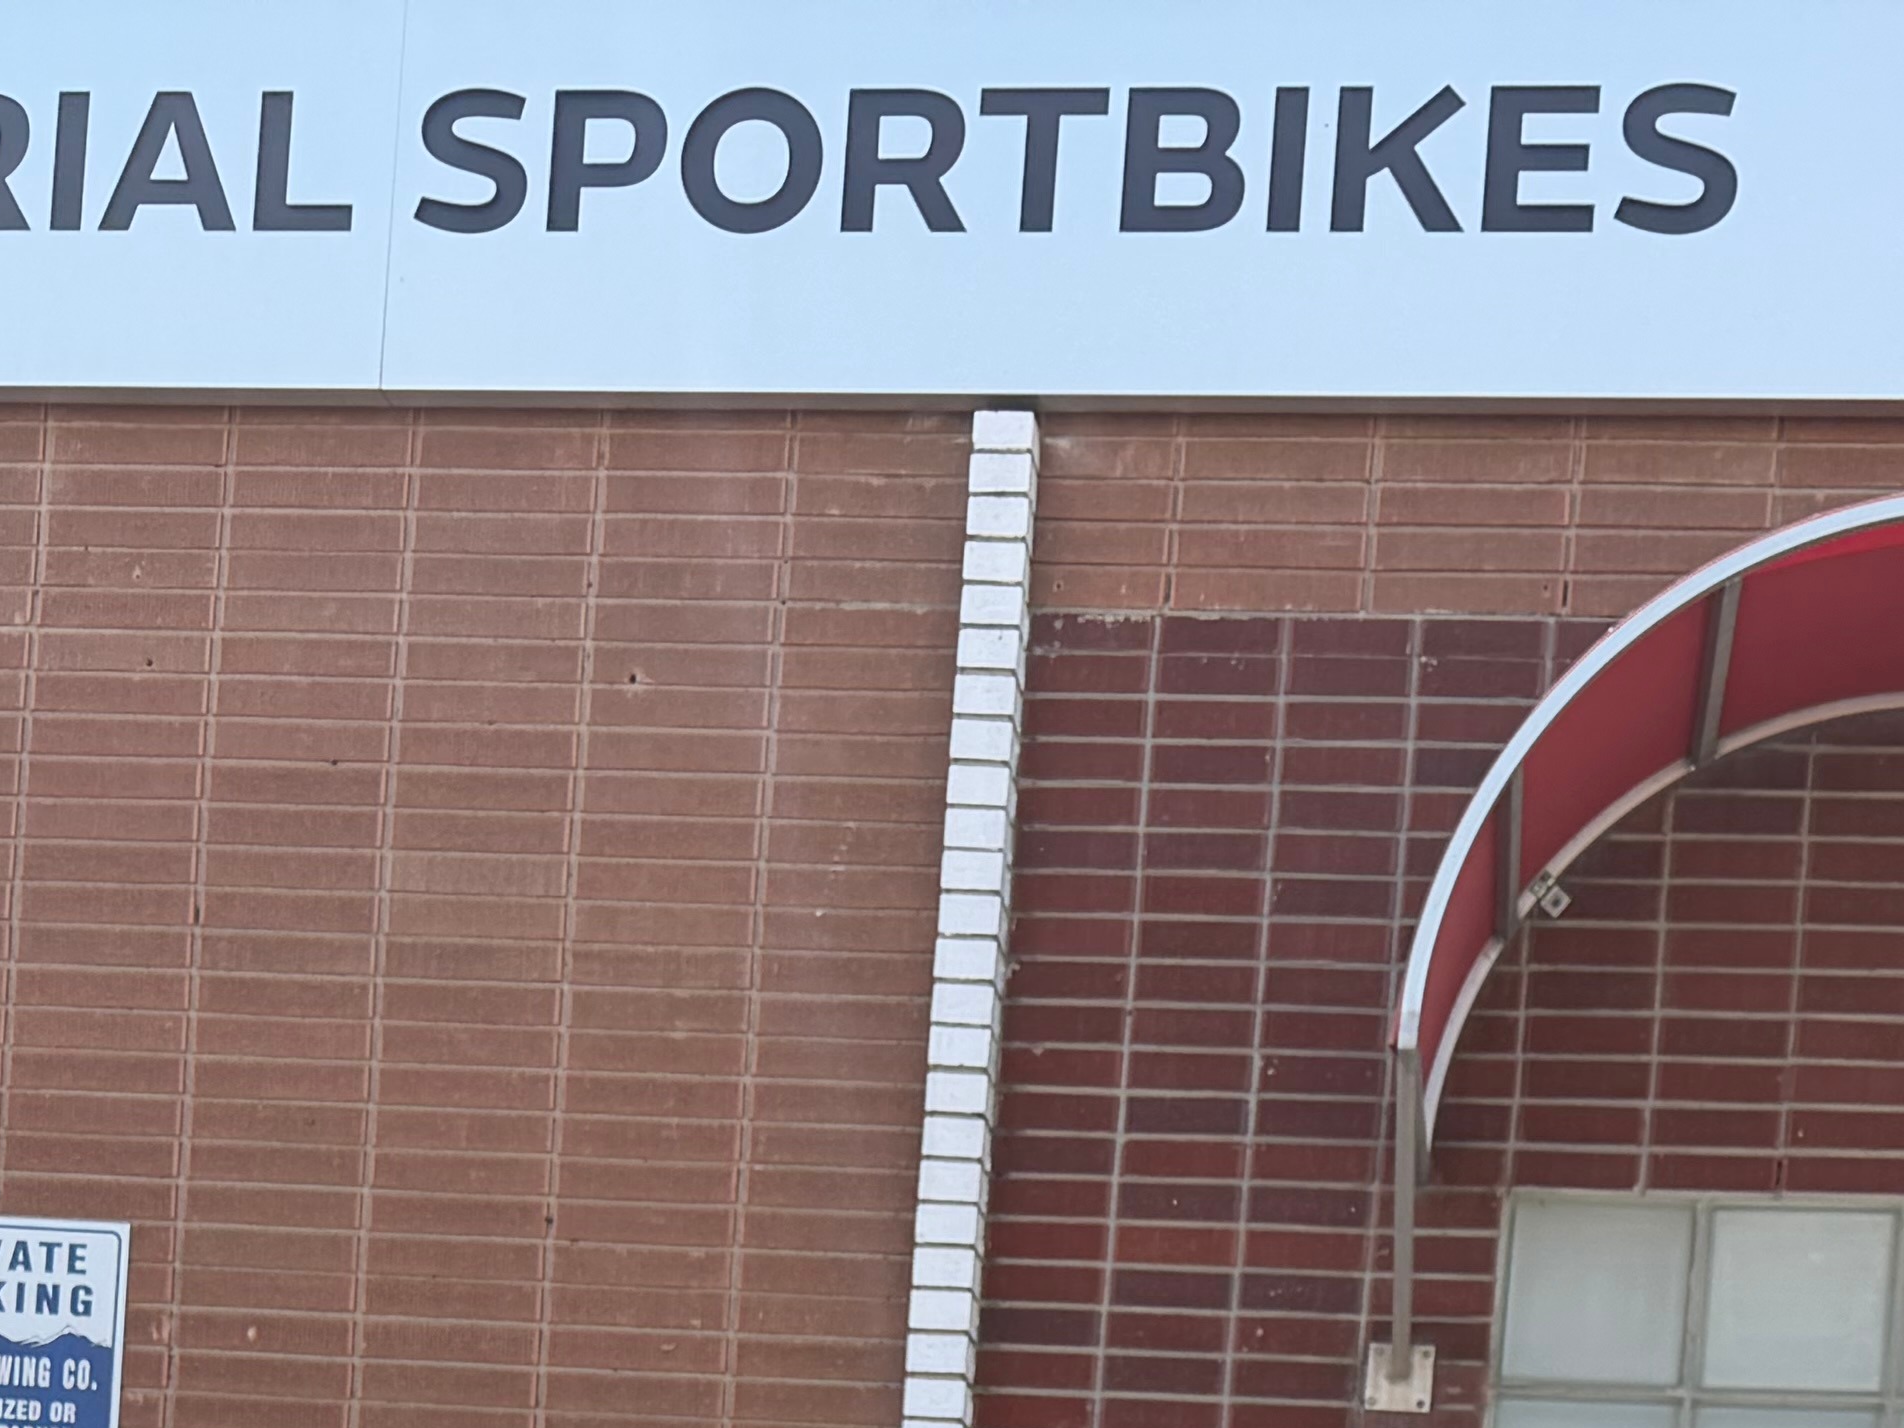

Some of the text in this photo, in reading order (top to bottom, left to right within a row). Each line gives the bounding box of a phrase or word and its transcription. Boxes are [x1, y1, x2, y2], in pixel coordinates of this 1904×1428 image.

[414, 83, 1739, 235] SPORTBIKES
[63, 1359, 98, 1391] CO.
[49, 1402, 76, 1423] OR
